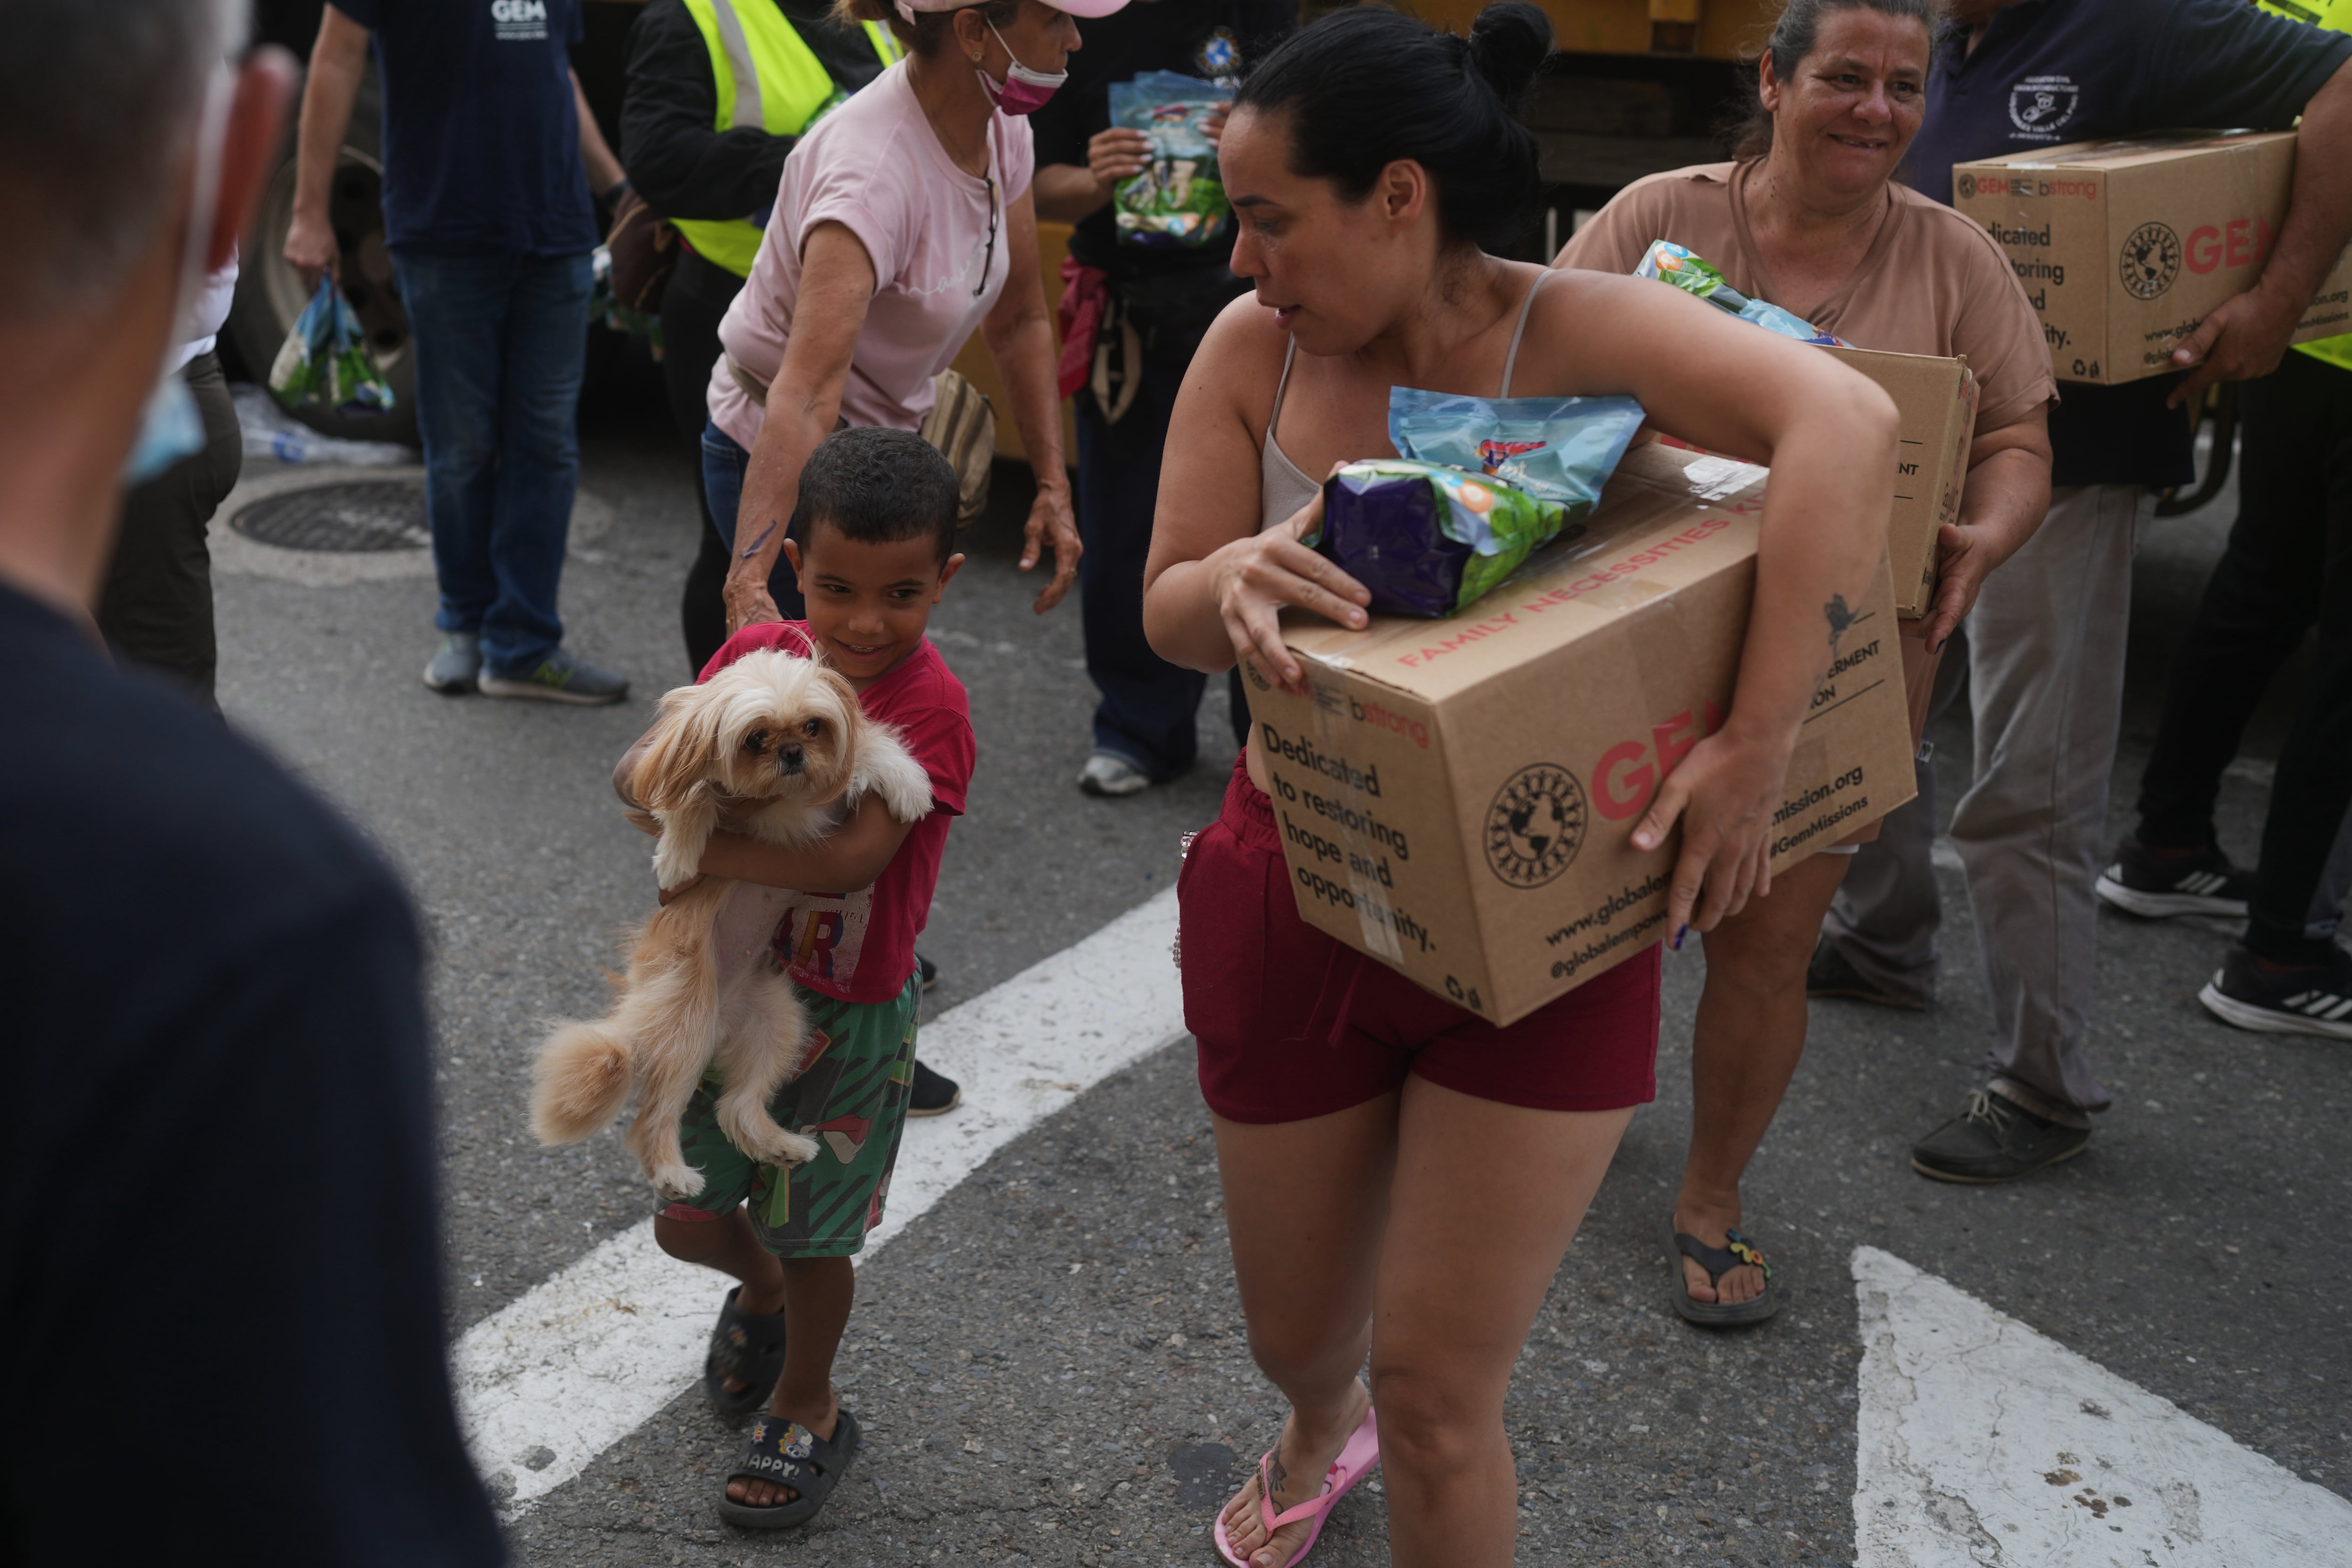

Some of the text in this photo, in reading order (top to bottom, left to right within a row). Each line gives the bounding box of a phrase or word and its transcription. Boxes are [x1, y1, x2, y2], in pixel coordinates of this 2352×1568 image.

[491, 0, 548, 22] GEM
[1977, 177, 2011, 194] GEM
[2039, 179, 2097, 199] bstrong
[1397, 612, 1518, 667] FAMILY
[1522, 518, 1730, 613] NECESSITIES
[1349, 694, 1429, 749] bstrong
[1262, 723, 1381, 797] Dedicated
[1273, 772, 1409, 861] to restoring
[1283, 810, 1393, 888] hope and
[1297, 867, 1437, 953] opportunity.
[736, 1453, 799, 1480] HAPPY!
